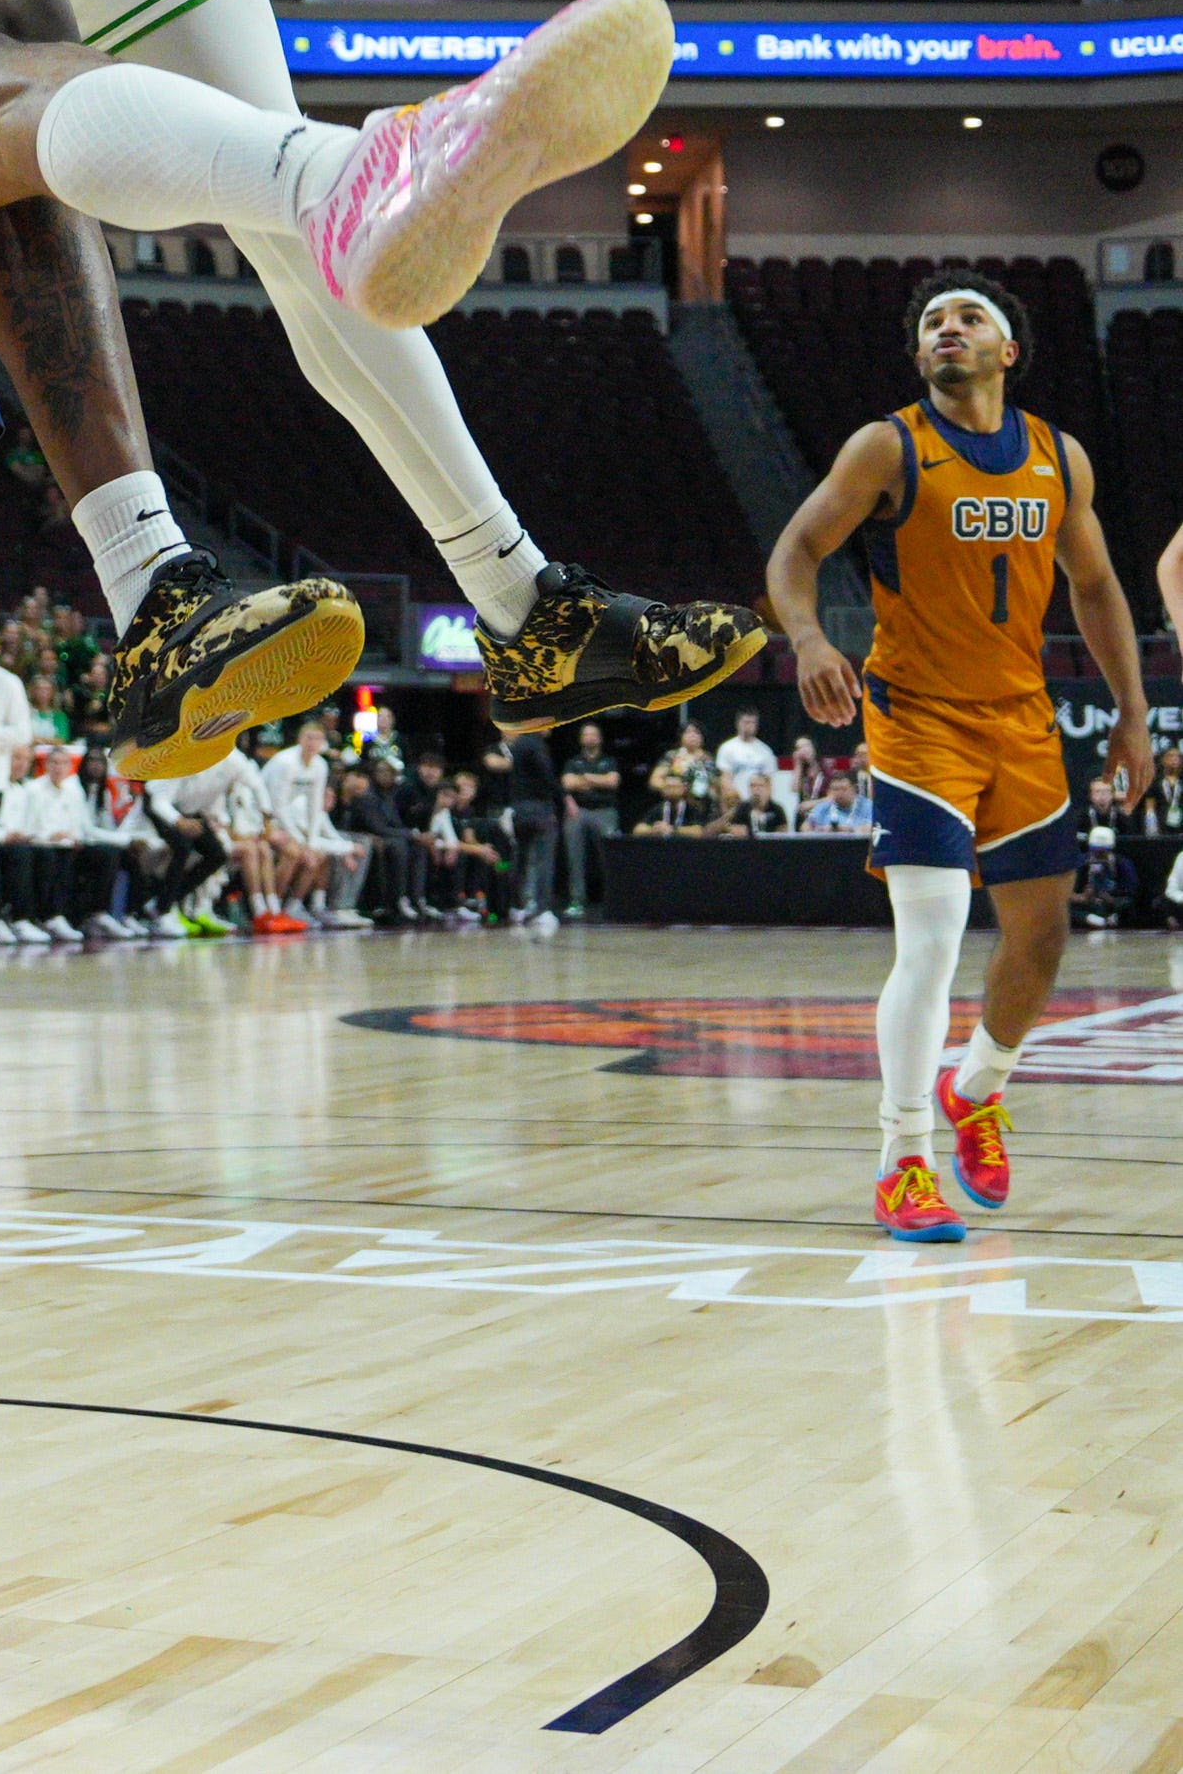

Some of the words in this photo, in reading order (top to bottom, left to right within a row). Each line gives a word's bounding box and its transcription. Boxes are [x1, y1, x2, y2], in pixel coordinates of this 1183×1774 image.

[756, 34, 833, 61] Bank
[836, 33, 902, 60] with
[905, 38, 972, 65] your
[976, 34, 1061, 60] brain.
[952, 497, 1049, 541] CBU
[991, 553, 1009, 624] 1
